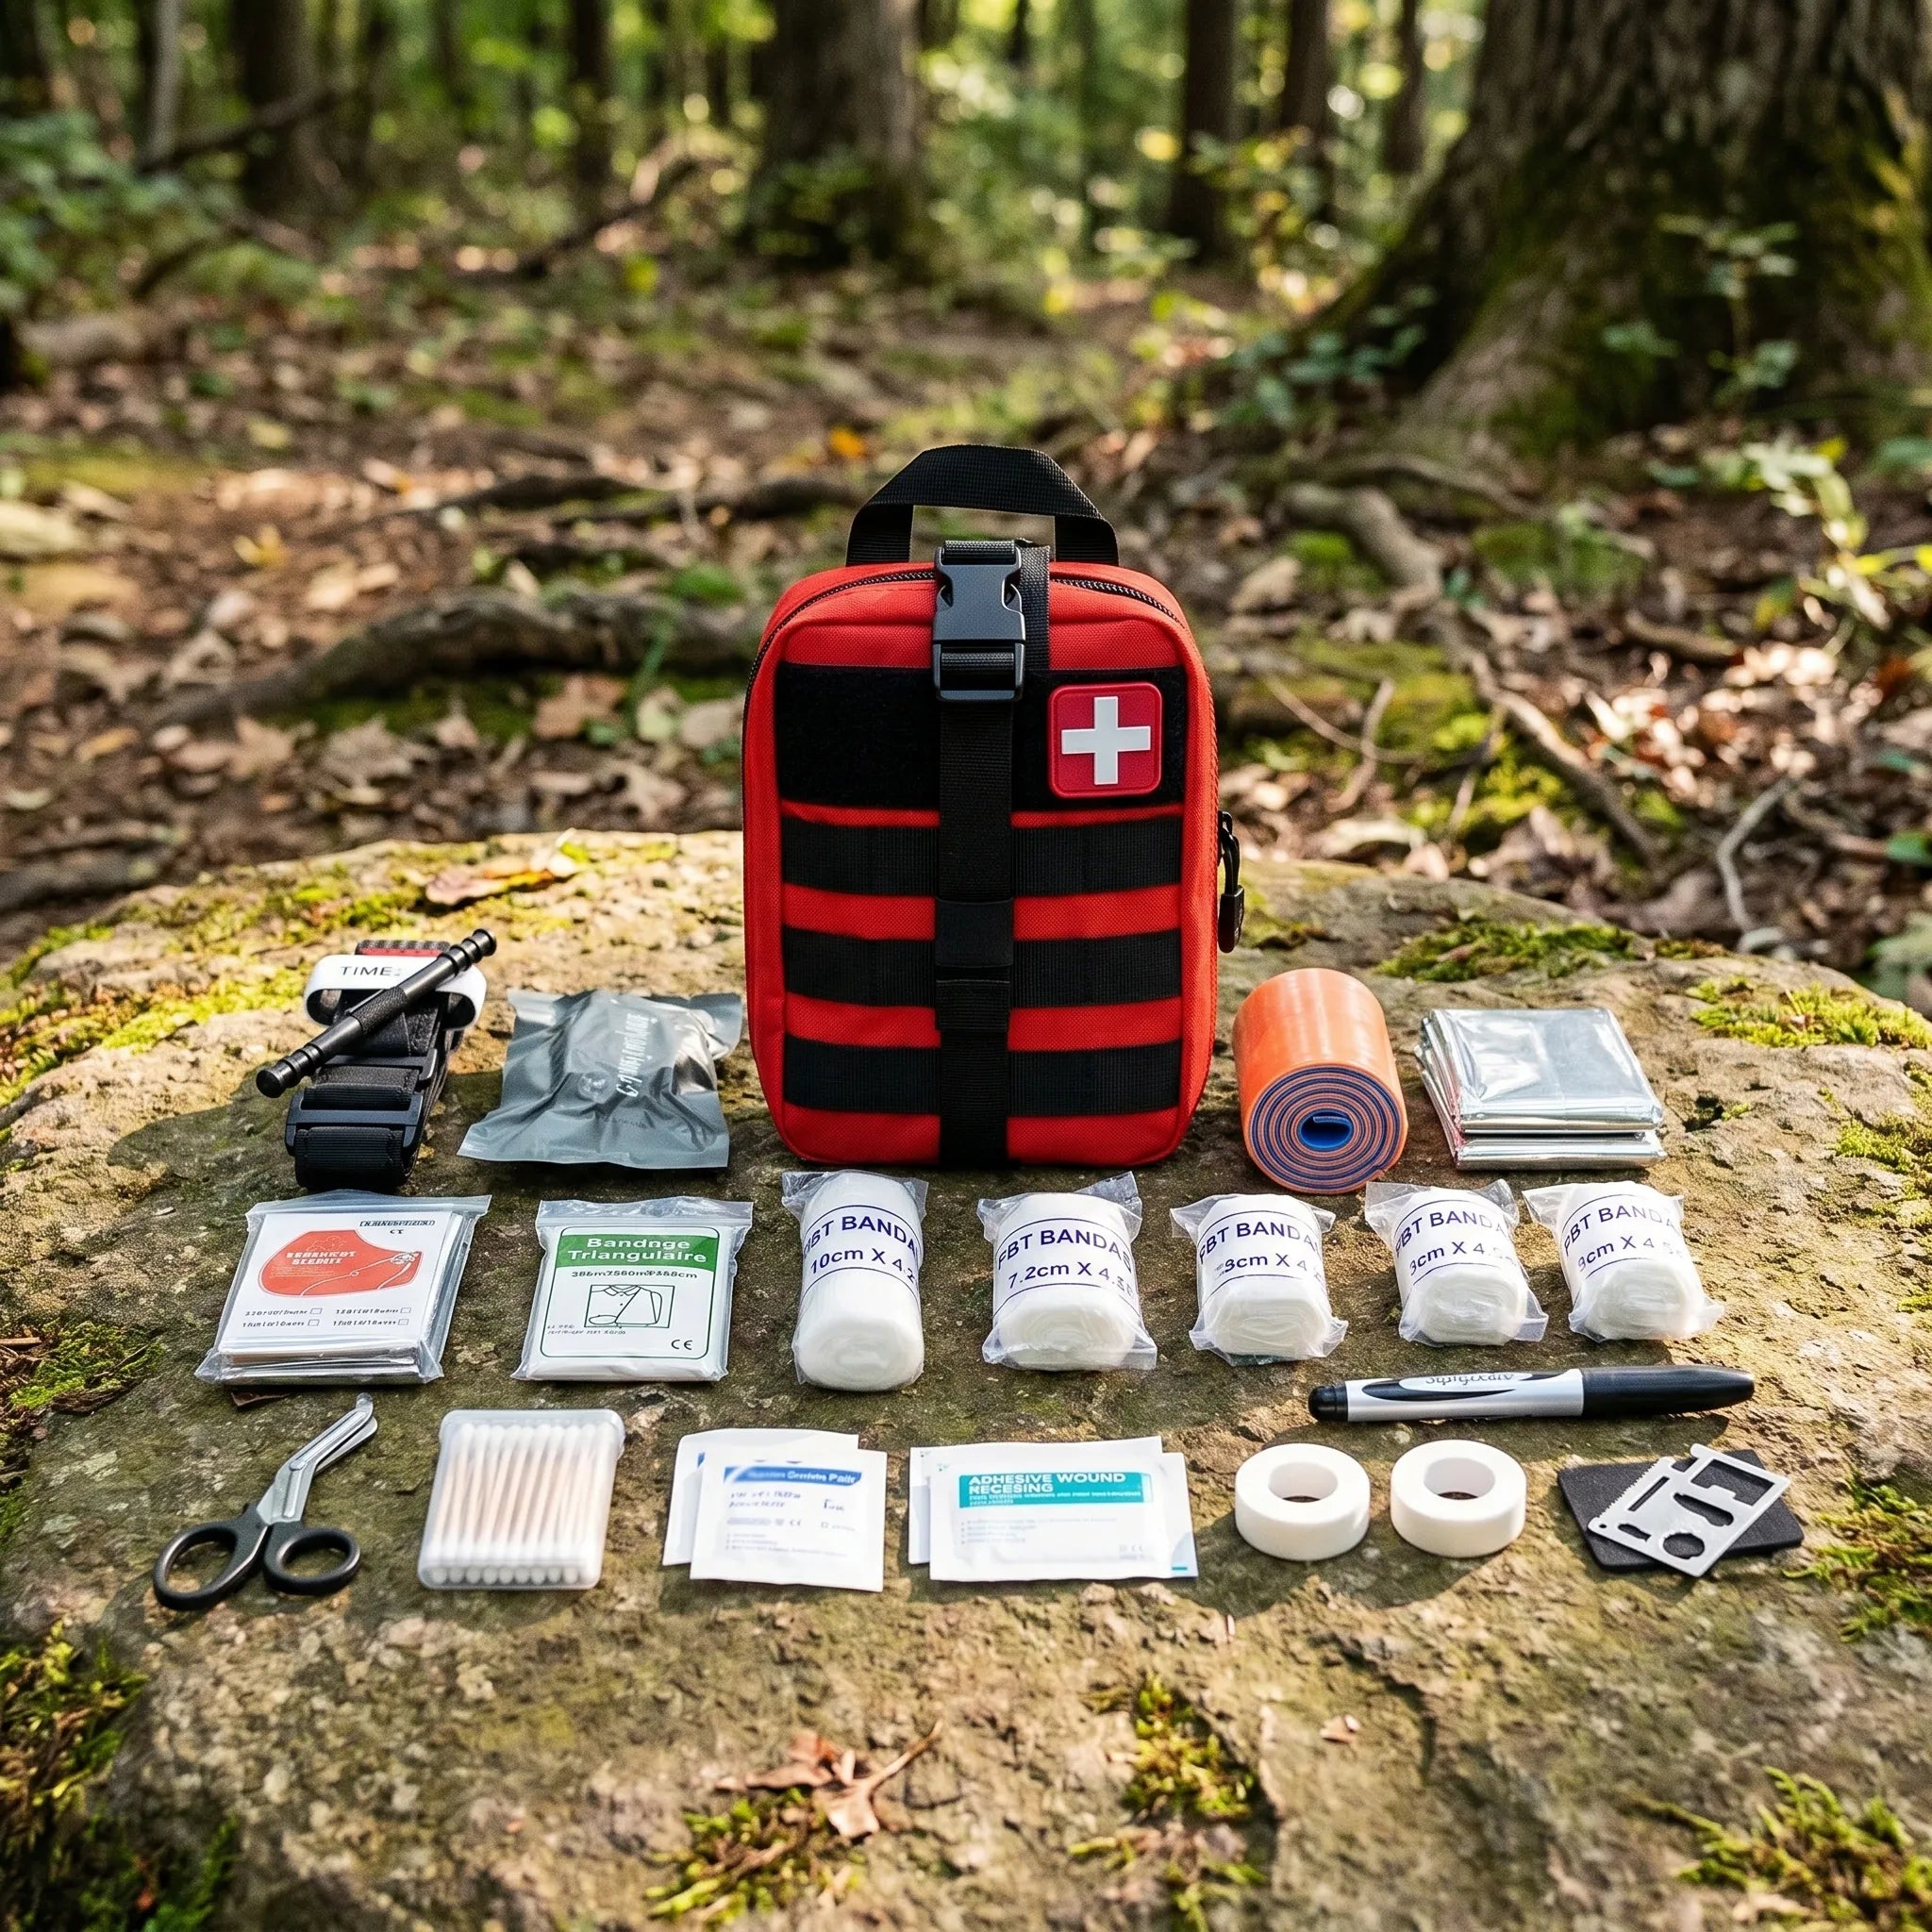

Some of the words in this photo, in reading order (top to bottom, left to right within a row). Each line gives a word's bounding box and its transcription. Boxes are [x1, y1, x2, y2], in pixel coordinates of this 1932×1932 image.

[841, 1215, 918, 1270] BANDA
[1451, 1241, 1467, 1255] X
[1620, 1235, 1637, 1250] X
[811, 1248, 863, 1274] 10cm
[872, 1247, 886, 1264] X
[1275, 1253, 1291, 1268] X
[1077, 1261, 1091, 1275] X
[672, 1339, 693, 1351] CE
[969, 1474, 1052, 1485] ADHESIVE
[1057, 1472, 1126, 1484] WOUND
